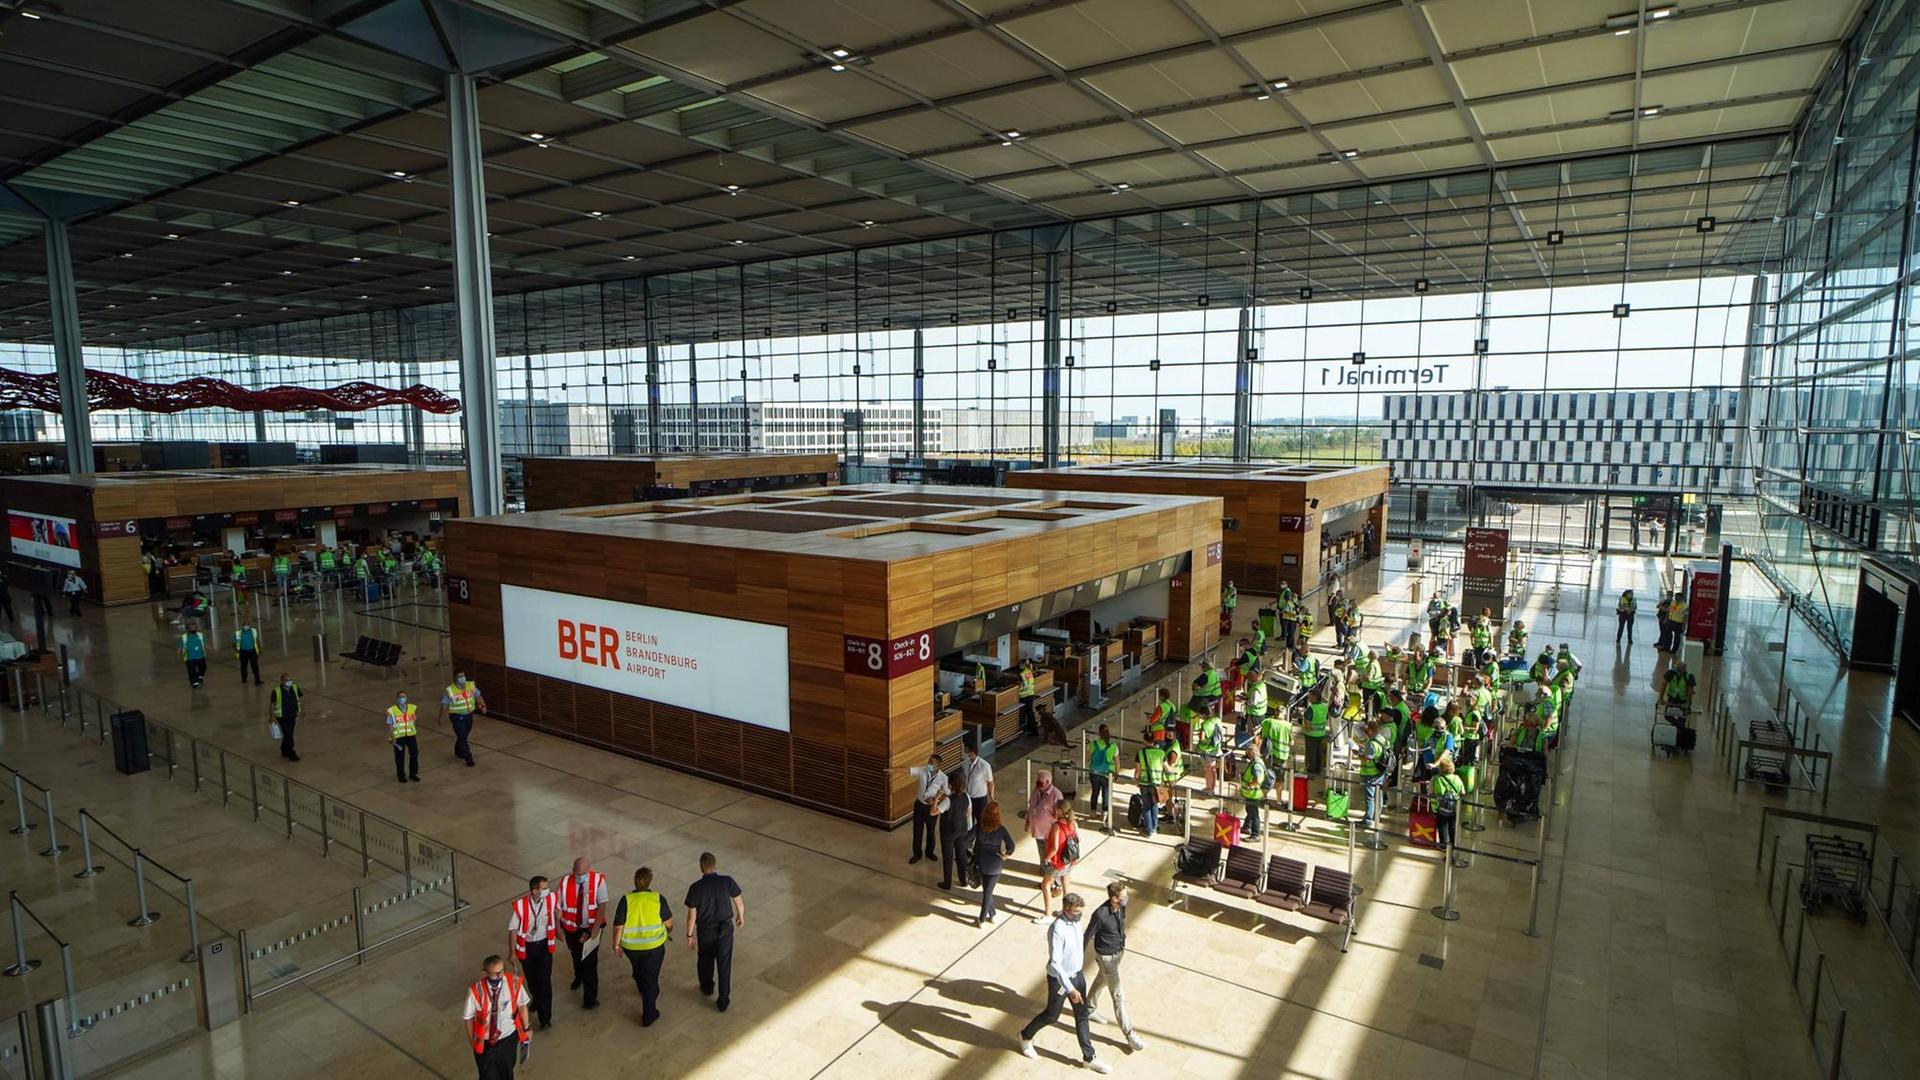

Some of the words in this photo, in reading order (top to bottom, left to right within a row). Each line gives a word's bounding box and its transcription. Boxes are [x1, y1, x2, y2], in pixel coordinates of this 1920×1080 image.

[125, 520, 136, 533] 6
[1293, 516, 1302, 529] 7
[1216, 543, 1222, 559] 8
[460, 580, 469, 599] 8
[557, 618, 621, 671] BER
[625, 630, 658, 646] BERLIN
[847, 639, 866, 647] Check-in
[893, 638, 916, 651] Check-in
[919, 633, 931, 661] 8
[625, 646, 698, 670] BRANDENBURG
[867, 643, 883, 671] 8
[626, 662, 667, 681] AIRPORT
